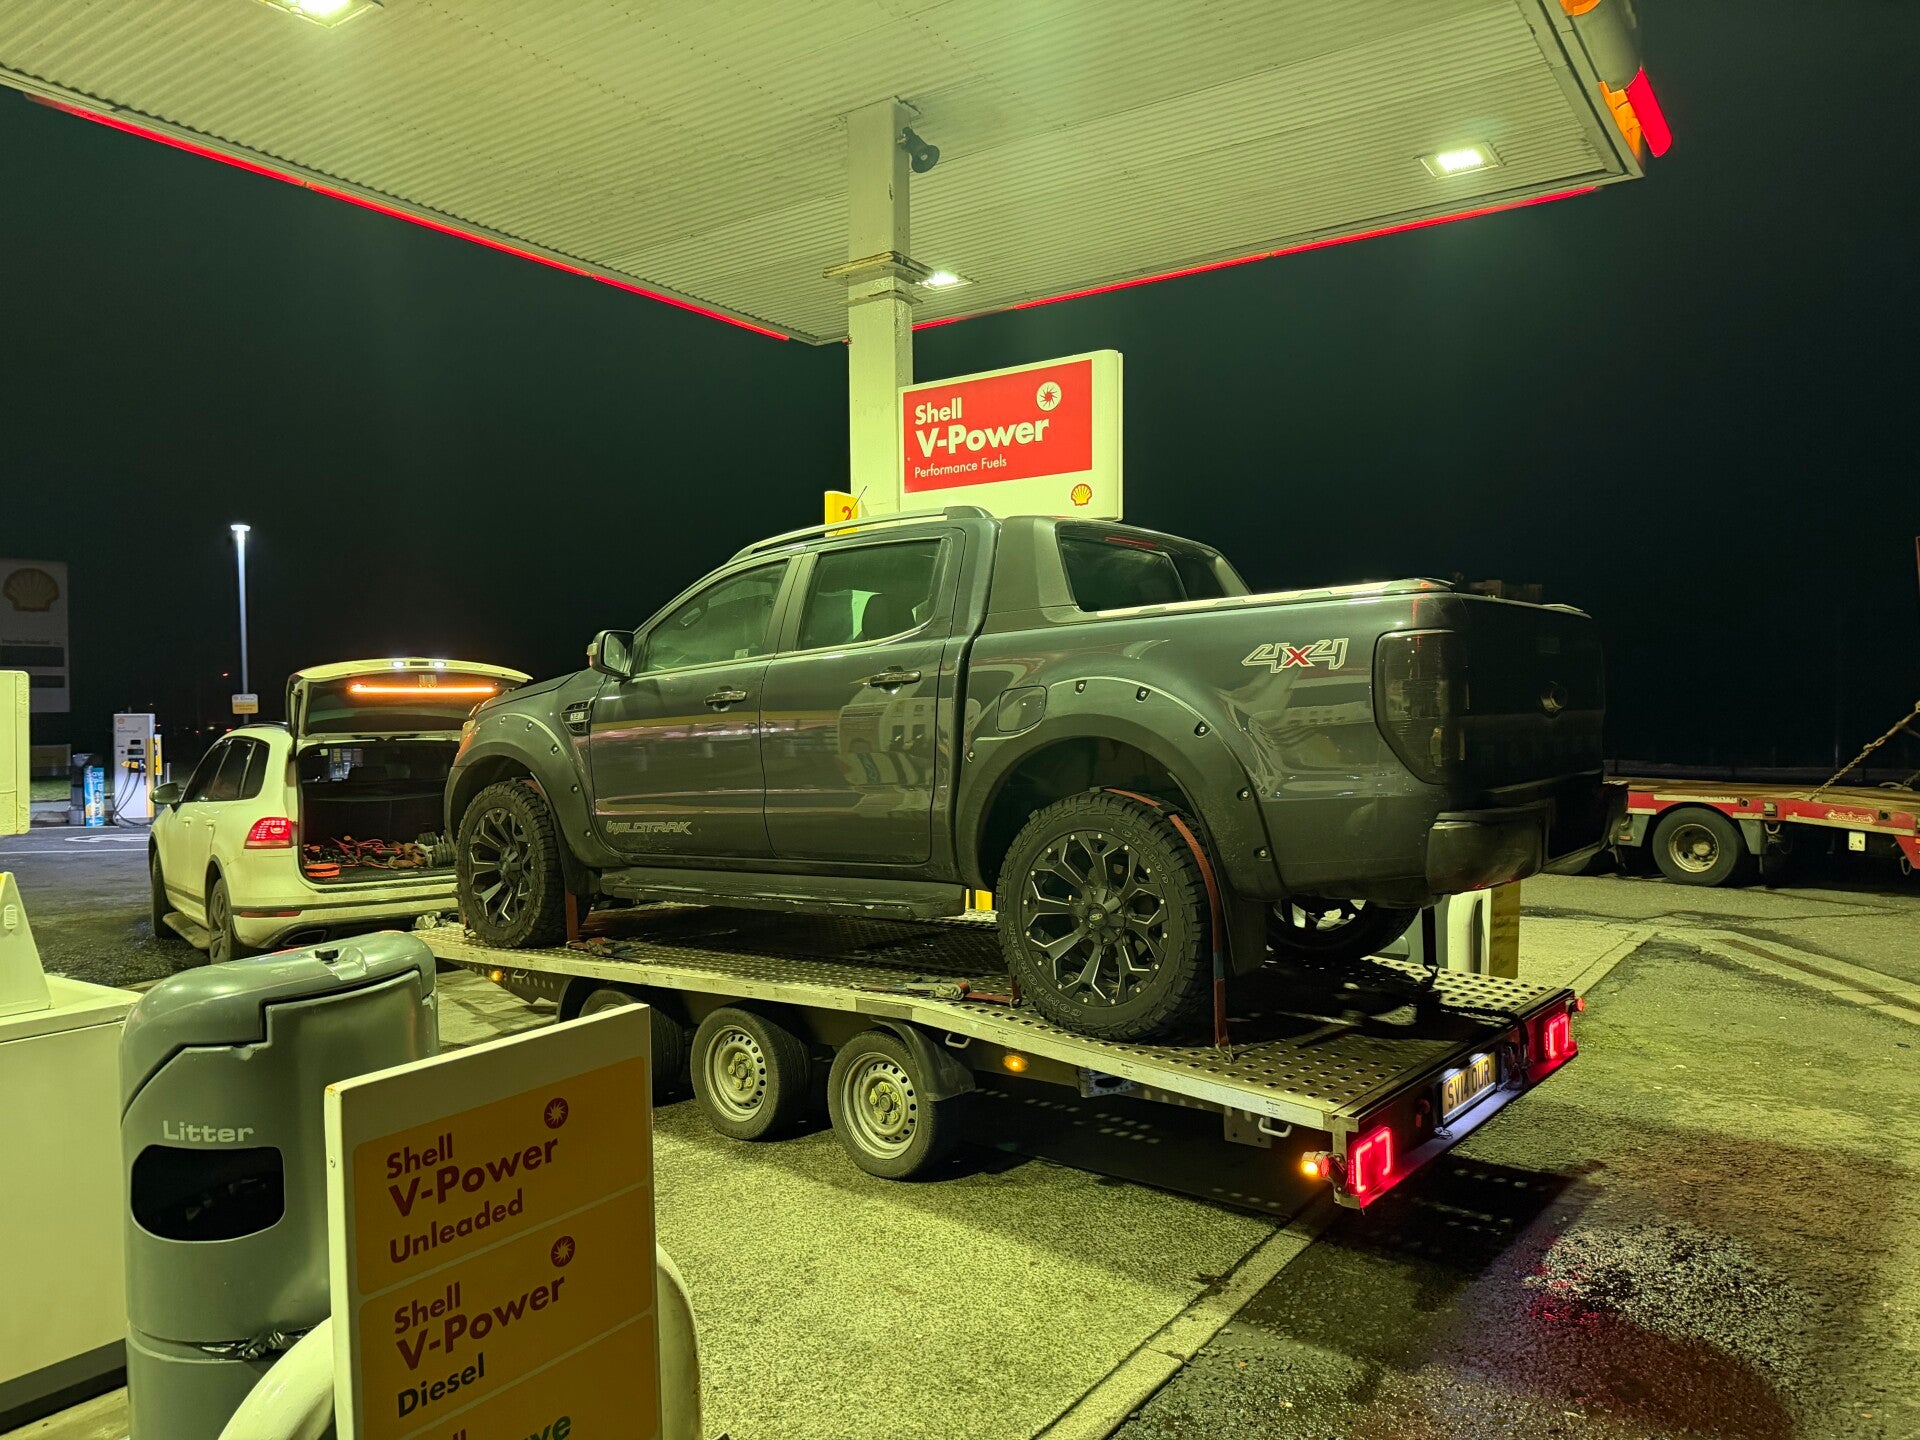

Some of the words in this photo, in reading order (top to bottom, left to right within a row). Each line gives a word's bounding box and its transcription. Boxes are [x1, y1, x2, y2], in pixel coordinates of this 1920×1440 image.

[915, 397, 963, 425] Shell
[915, 419, 1050, 458] V-Power
[914, 461, 978, 479] Performance
[981, 454, 1007, 471] Fuels
[606, 820, 693, 835] WILDTRAK
[162, 1120, 255, 1143] Litter
[386, 1132, 453, 1179] Shell
[388, 1138, 558, 1218] V-Power
[389, 1188, 524, 1264] Unleaded
[394, 1282, 461, 1335] Shell
[396, 1276, 566, 1371] V-Power
[397, 1353, 486, 1418] Diesel
